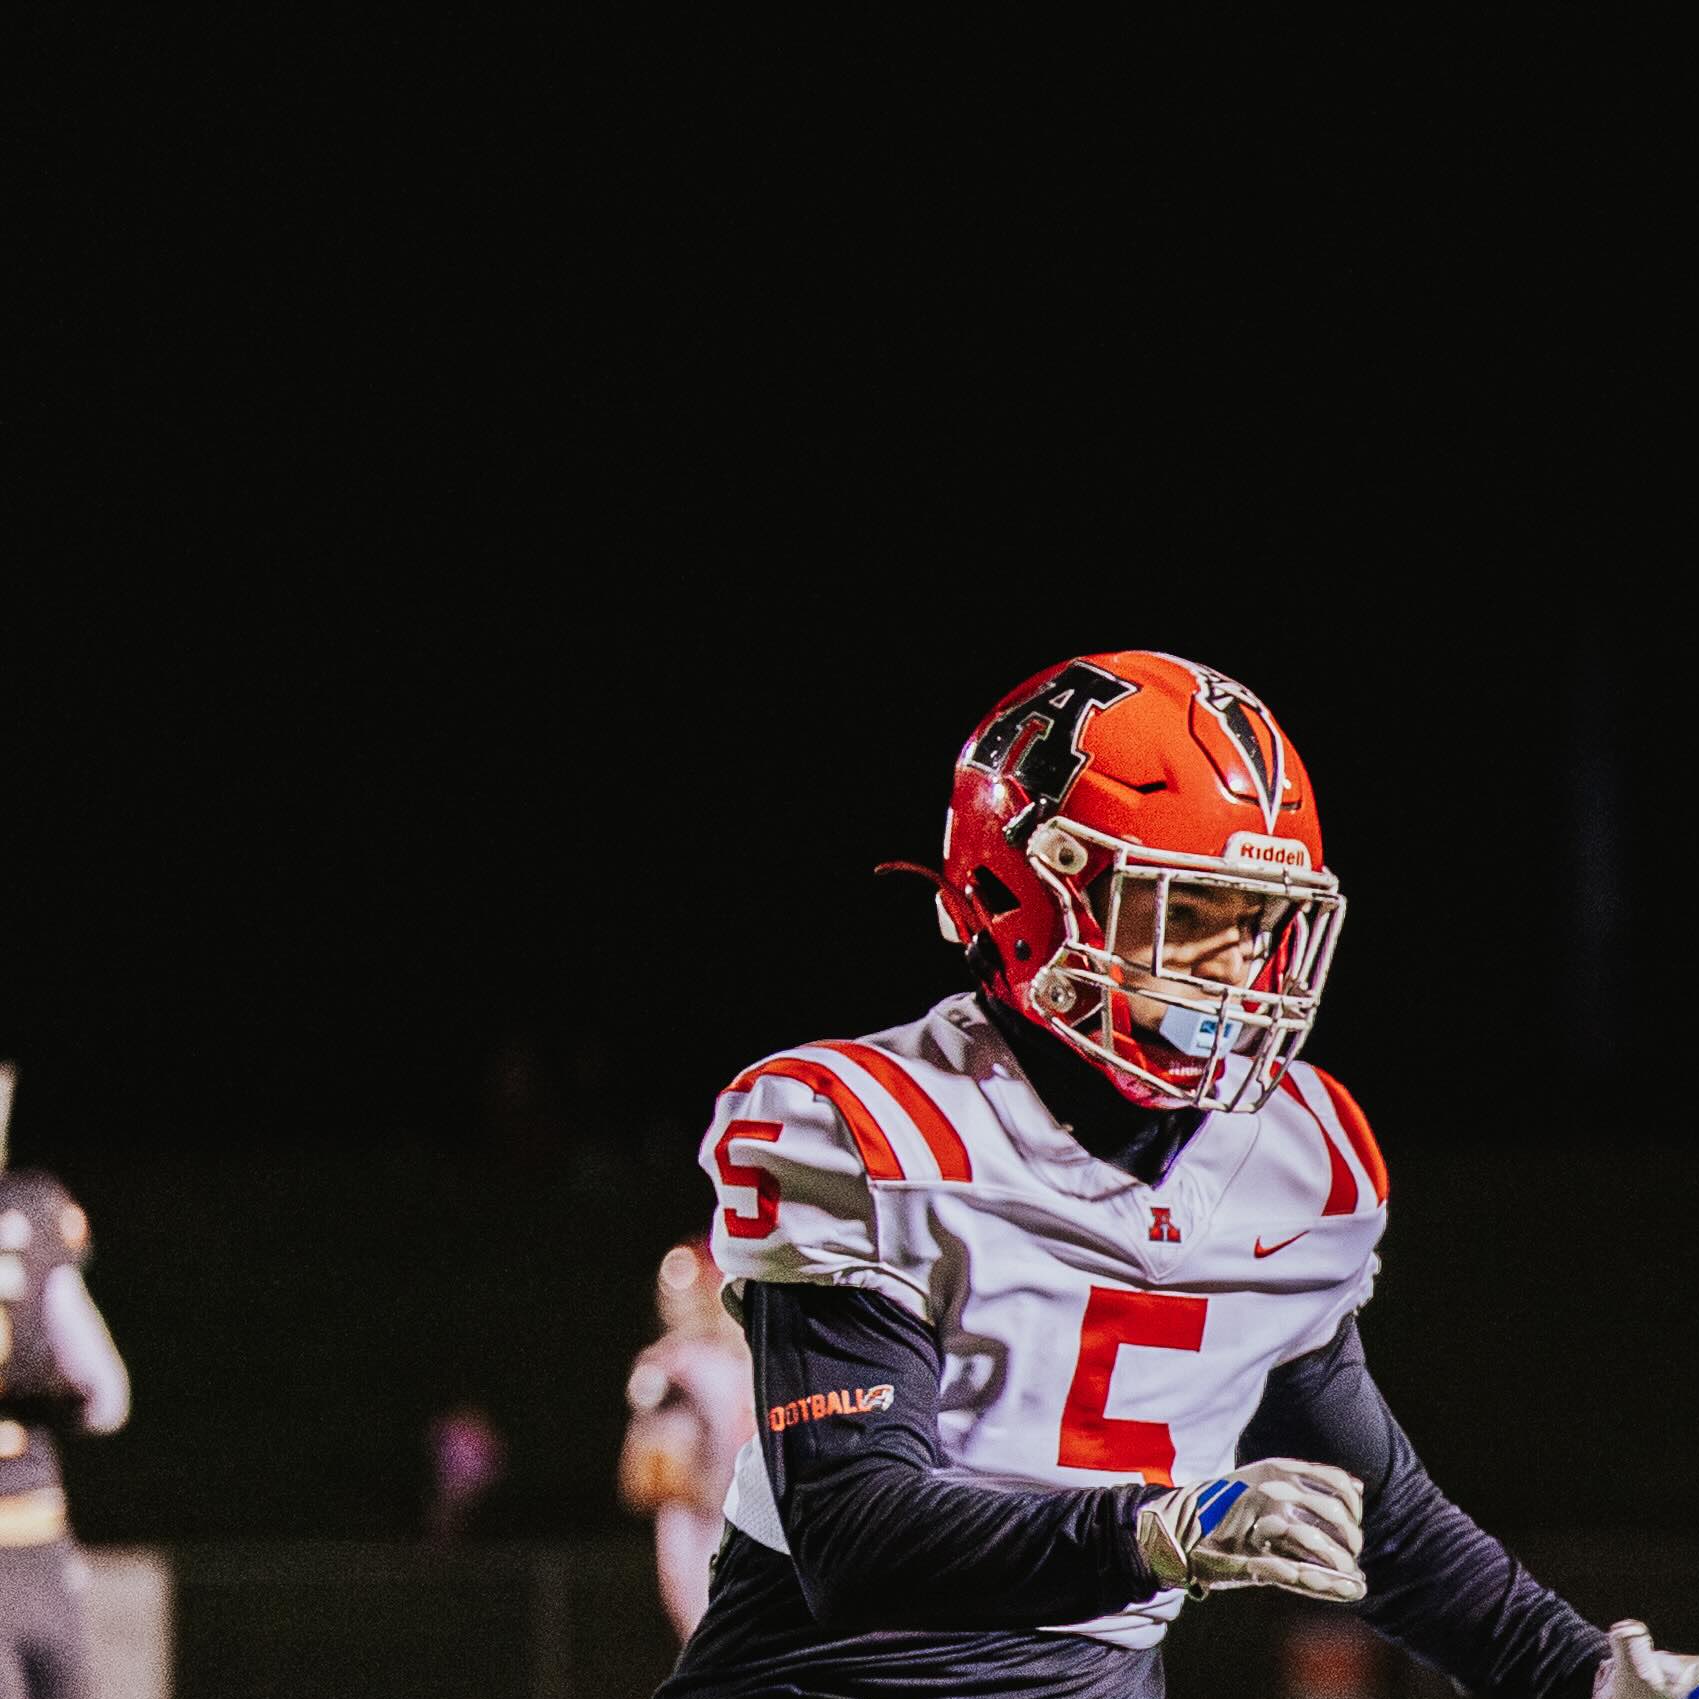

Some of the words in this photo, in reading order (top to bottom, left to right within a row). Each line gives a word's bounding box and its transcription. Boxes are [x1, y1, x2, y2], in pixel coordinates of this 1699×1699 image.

[1240, 843, 1305, 867] Riddell
[714, 1119, 784, 1239] 5
[1149, 1206, 1182, 1243] A
